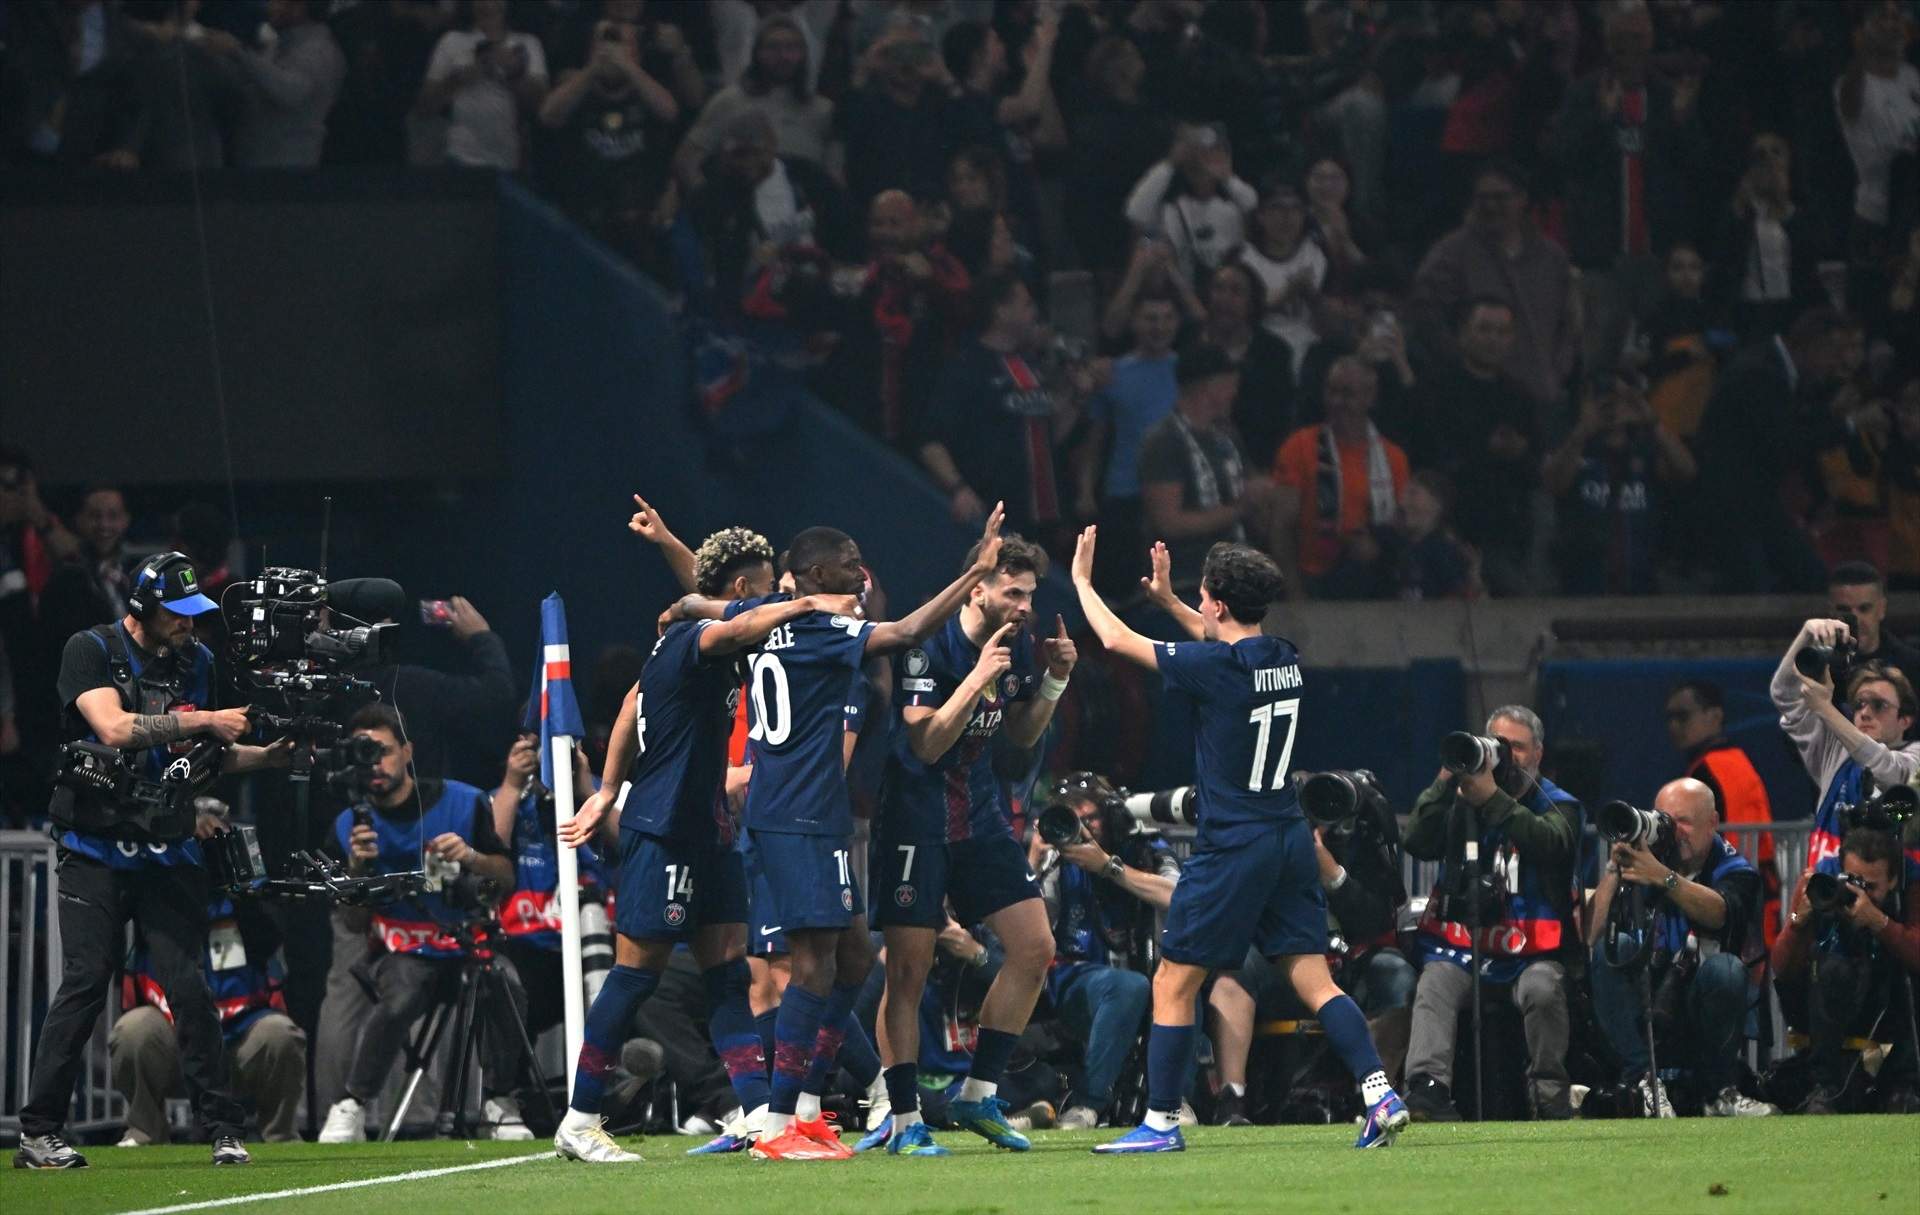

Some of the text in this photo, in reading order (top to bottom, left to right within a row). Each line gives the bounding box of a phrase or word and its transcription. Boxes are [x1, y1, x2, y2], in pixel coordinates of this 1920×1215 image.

[1254, 664, 1303, 692] VITINHA
[1249, 698, 1300, 792] 17
[898, 845, 916, 881] 7
[665, 864, 694, 902] 14
